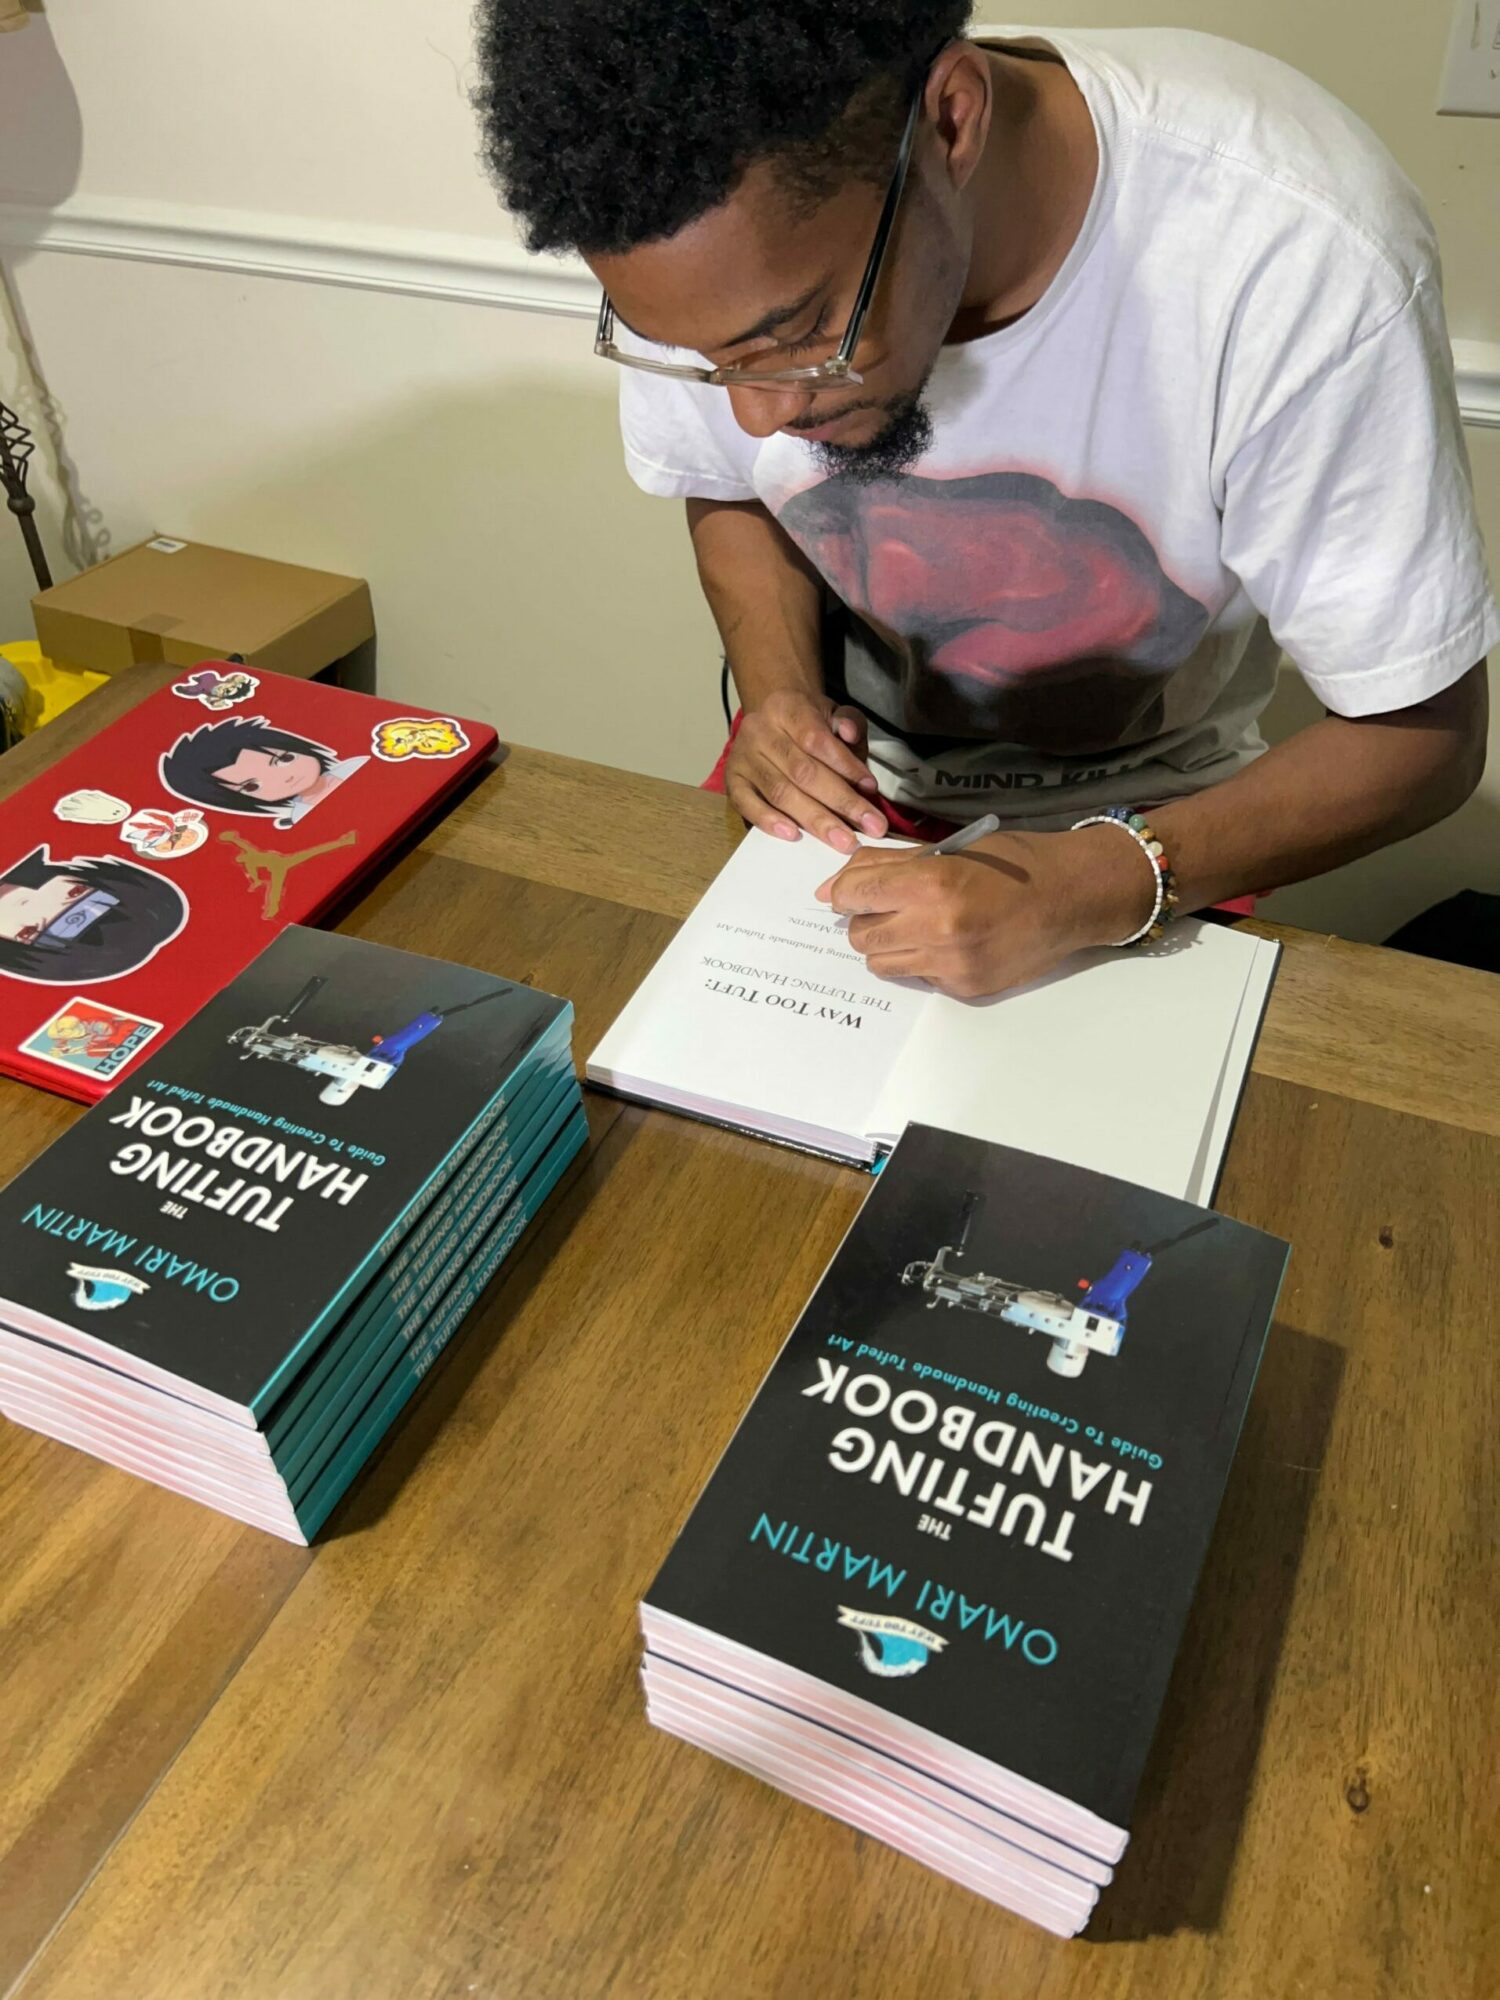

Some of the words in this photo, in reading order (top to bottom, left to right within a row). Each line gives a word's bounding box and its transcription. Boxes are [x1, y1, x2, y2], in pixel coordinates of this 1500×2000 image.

[935, 769, 1044, 789] MIND
[716, 922, 733, 933] Art
[734, 926, 766, 940] Tufted
[768, 934, 824, 954] Handmade
[702, 956, 788, 986] HANDBOOK
[790, 978, 857, 1004] TUFTING
[96, 1025, 154, 1075] HOPE
[146, 1081, 166, 1094] Art
[168, 1084, 206, 1108] Tufted
[208, 1097, 272, 1126] Handmade
[274, 1117, 326, 1144] Creating
[328, 1138, 345, 1153] To
[110, 1096, 368, 1205] HANDBOOK
[348, 1142, 386, 1167] Guide
[110, 1143, 295, 1232] TUFTING
[380, 1227, 400, 1256] THE
[402, 1170, 446, 1227] TUFTING
[447, 1092, 505, 1171] HANDBOOK
[160, 1201, 188, 1219] THE
[388, 1252, 408, 1281] THE
[410, 1195, 452, 1251] TUFTING
[454, 1116, 508, 1194] HANDBOOK
[20, 1203, 137, 1256] MARTIN
[391, 1273, 411, 1302] THE
[413, 1215, 453, 1272] TUFTING
[455, 1136, 509, 1215] HANDBOOK
[397, 1291, 417, 1320] THE
[418, 1232, 458, 1290] TUFTING
[459, 1154, 513, 1233] HANDBOOK
[131, 1244, 240, 1303] OMARI
[402, 1311, 422, 1340] THE
[422, 1253, 464, 1310] TUFTING
[464, 1175, 518, 1252] HANDBOOK
[410, 1333, 428, 1361] THE
[430, 1274, 469, 1331] TUFTING
[471, 1198, 523, 1274] HANDBOOK
[415, 1349, 434, 1378] THE
[435, 1291, 474, 1349] TUFTING
[475, 1213, 527, 1291] HANDBOOK
[827, 1334, 854, 1352] Art
[856, 1343, 907, 1372] Tufted
[913, 1361, 1000, 1404] Handmade
[1006, 1393, 1079, 1435] Creating
[801, 1357, 1153, 1525] HANDBOOK
[1085, 1426, 1104, 1445] To
[1110, 1437, 1163, 1470] Guide
[828, 1427, 1075, 1562] TUFTING
[917, 1513, 952, 1541] THE
[750, 1513, 906, 1597] MARTIN
[916, 1580, 1058, 1666] OMARI
